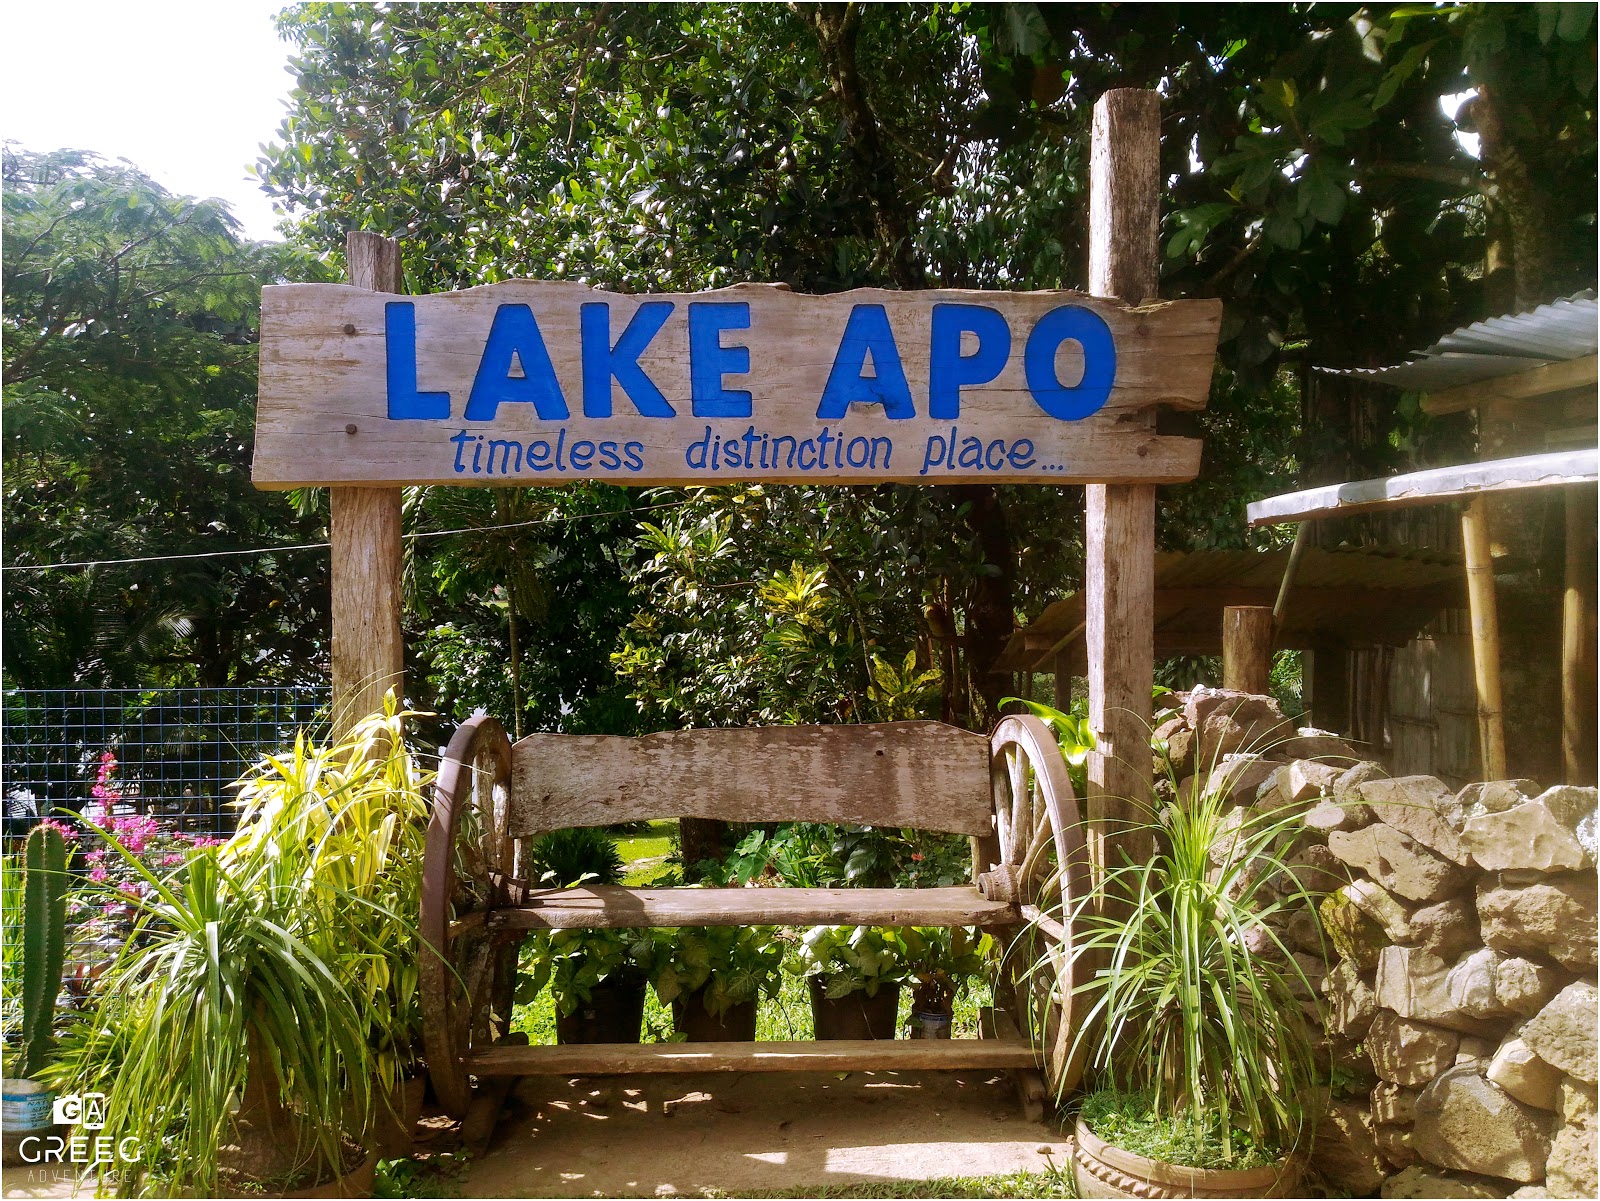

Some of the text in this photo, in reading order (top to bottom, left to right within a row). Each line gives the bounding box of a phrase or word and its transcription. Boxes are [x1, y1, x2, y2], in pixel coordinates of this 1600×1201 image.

[385, 301, 1116, 421] LAKE APO
[449, 425, 1065, 475] timeless distinction place...
